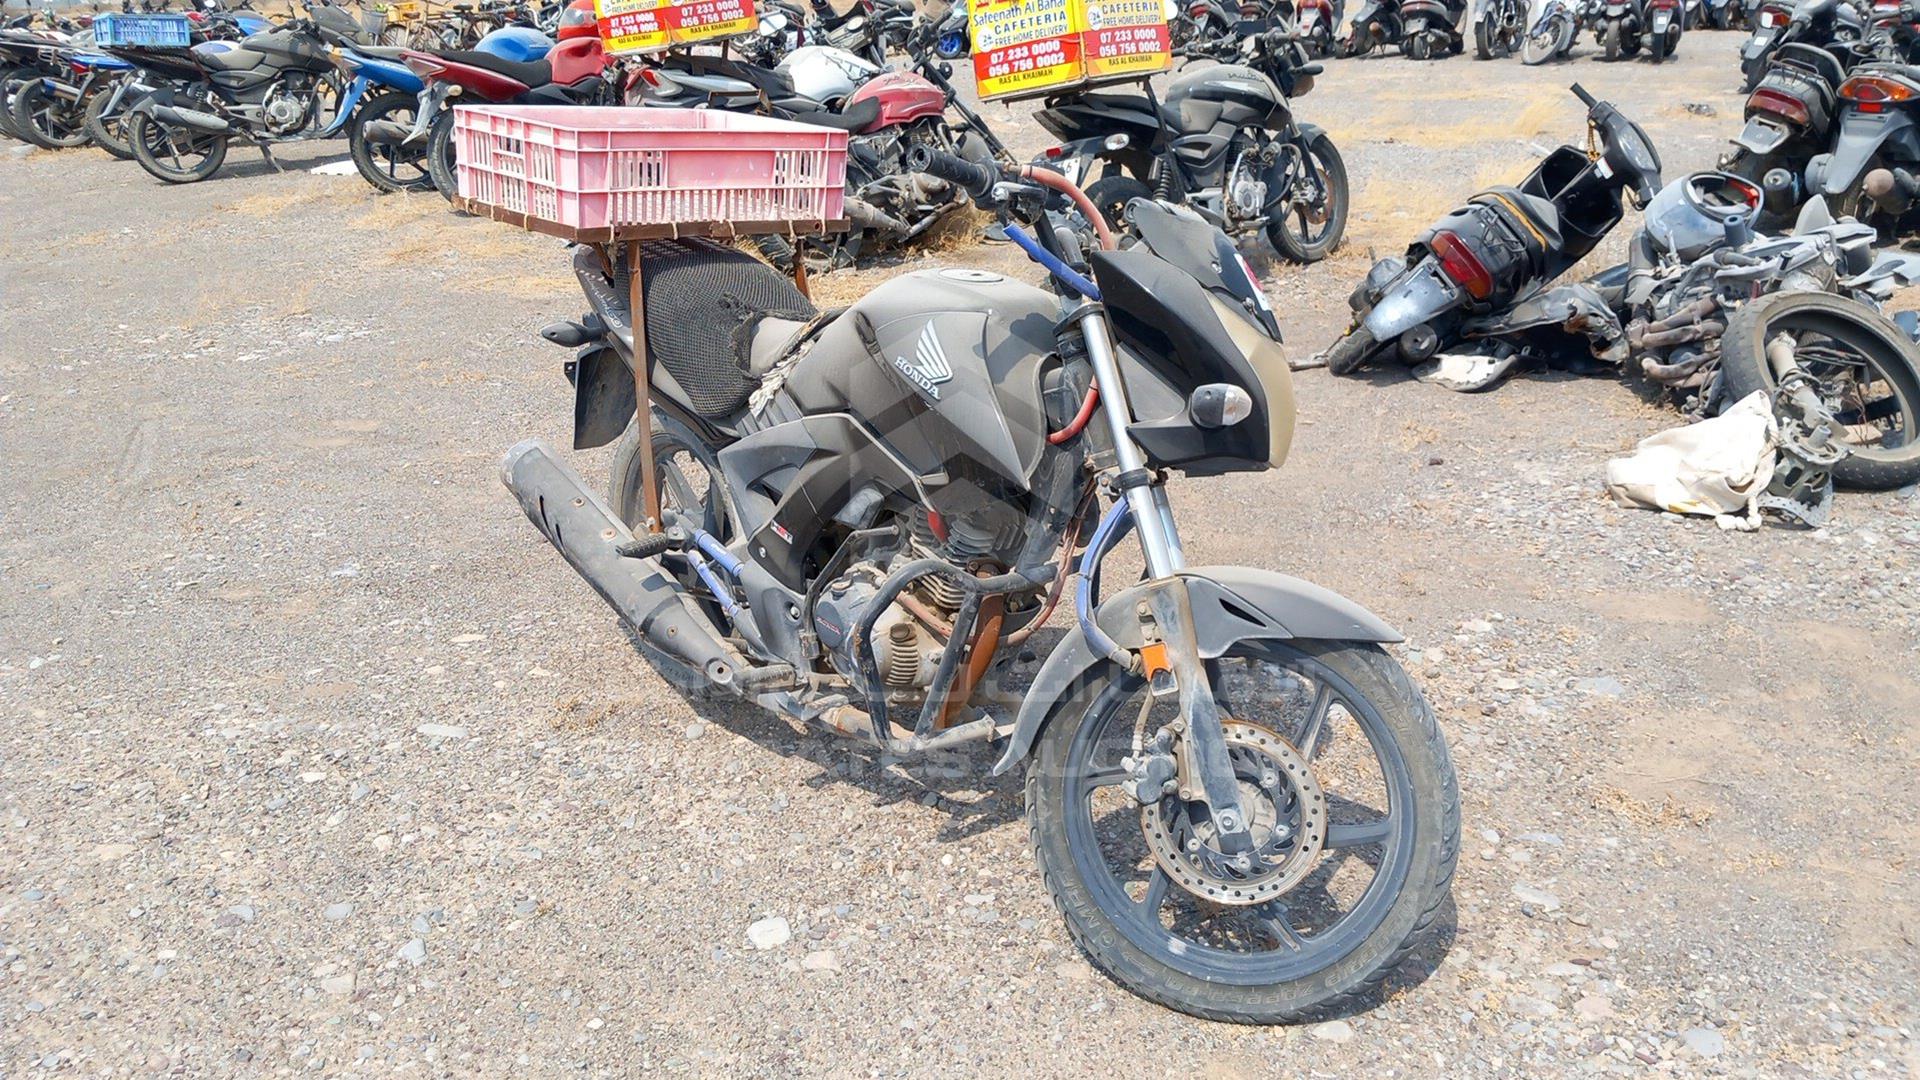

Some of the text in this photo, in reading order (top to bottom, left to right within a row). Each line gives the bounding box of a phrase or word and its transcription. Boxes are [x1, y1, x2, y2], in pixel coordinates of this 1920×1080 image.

[681, 0, 739, 17] 07 233 0000
[973, 5, 1022, 27] Safeenath
[1024, 2, 1035, 13] Al
[1102, 1, 1159, 15] CAFETERIA
[680, 9, 745, 28] 056 756 0002
[994, 10, 1066, 35] CAFETERIA
[1103, 17, 1117, 26] FREE
[1118, 15, 1134, 25] HOME
[995, 35, 1012, 47] FREE
[1013, 31, 1034, 43] HOME
[1034, 24, 1068, 38] DELIVERY
[1100, 28, 1157, 43] 07 233 0000
[990, 40, 1060, 64] 07 233 0000
[1099, 40, 1161, 57] 056 756 0002
[988, 52, 1065, 77] 056 756 0002
[1108, 57, 1120, 66] RAS
[1121, 56, 1127, 64] AL
[998, 68, 1053, 85] RAS AL KHAIMAH
[894, 355, 942, 400] HONDA
